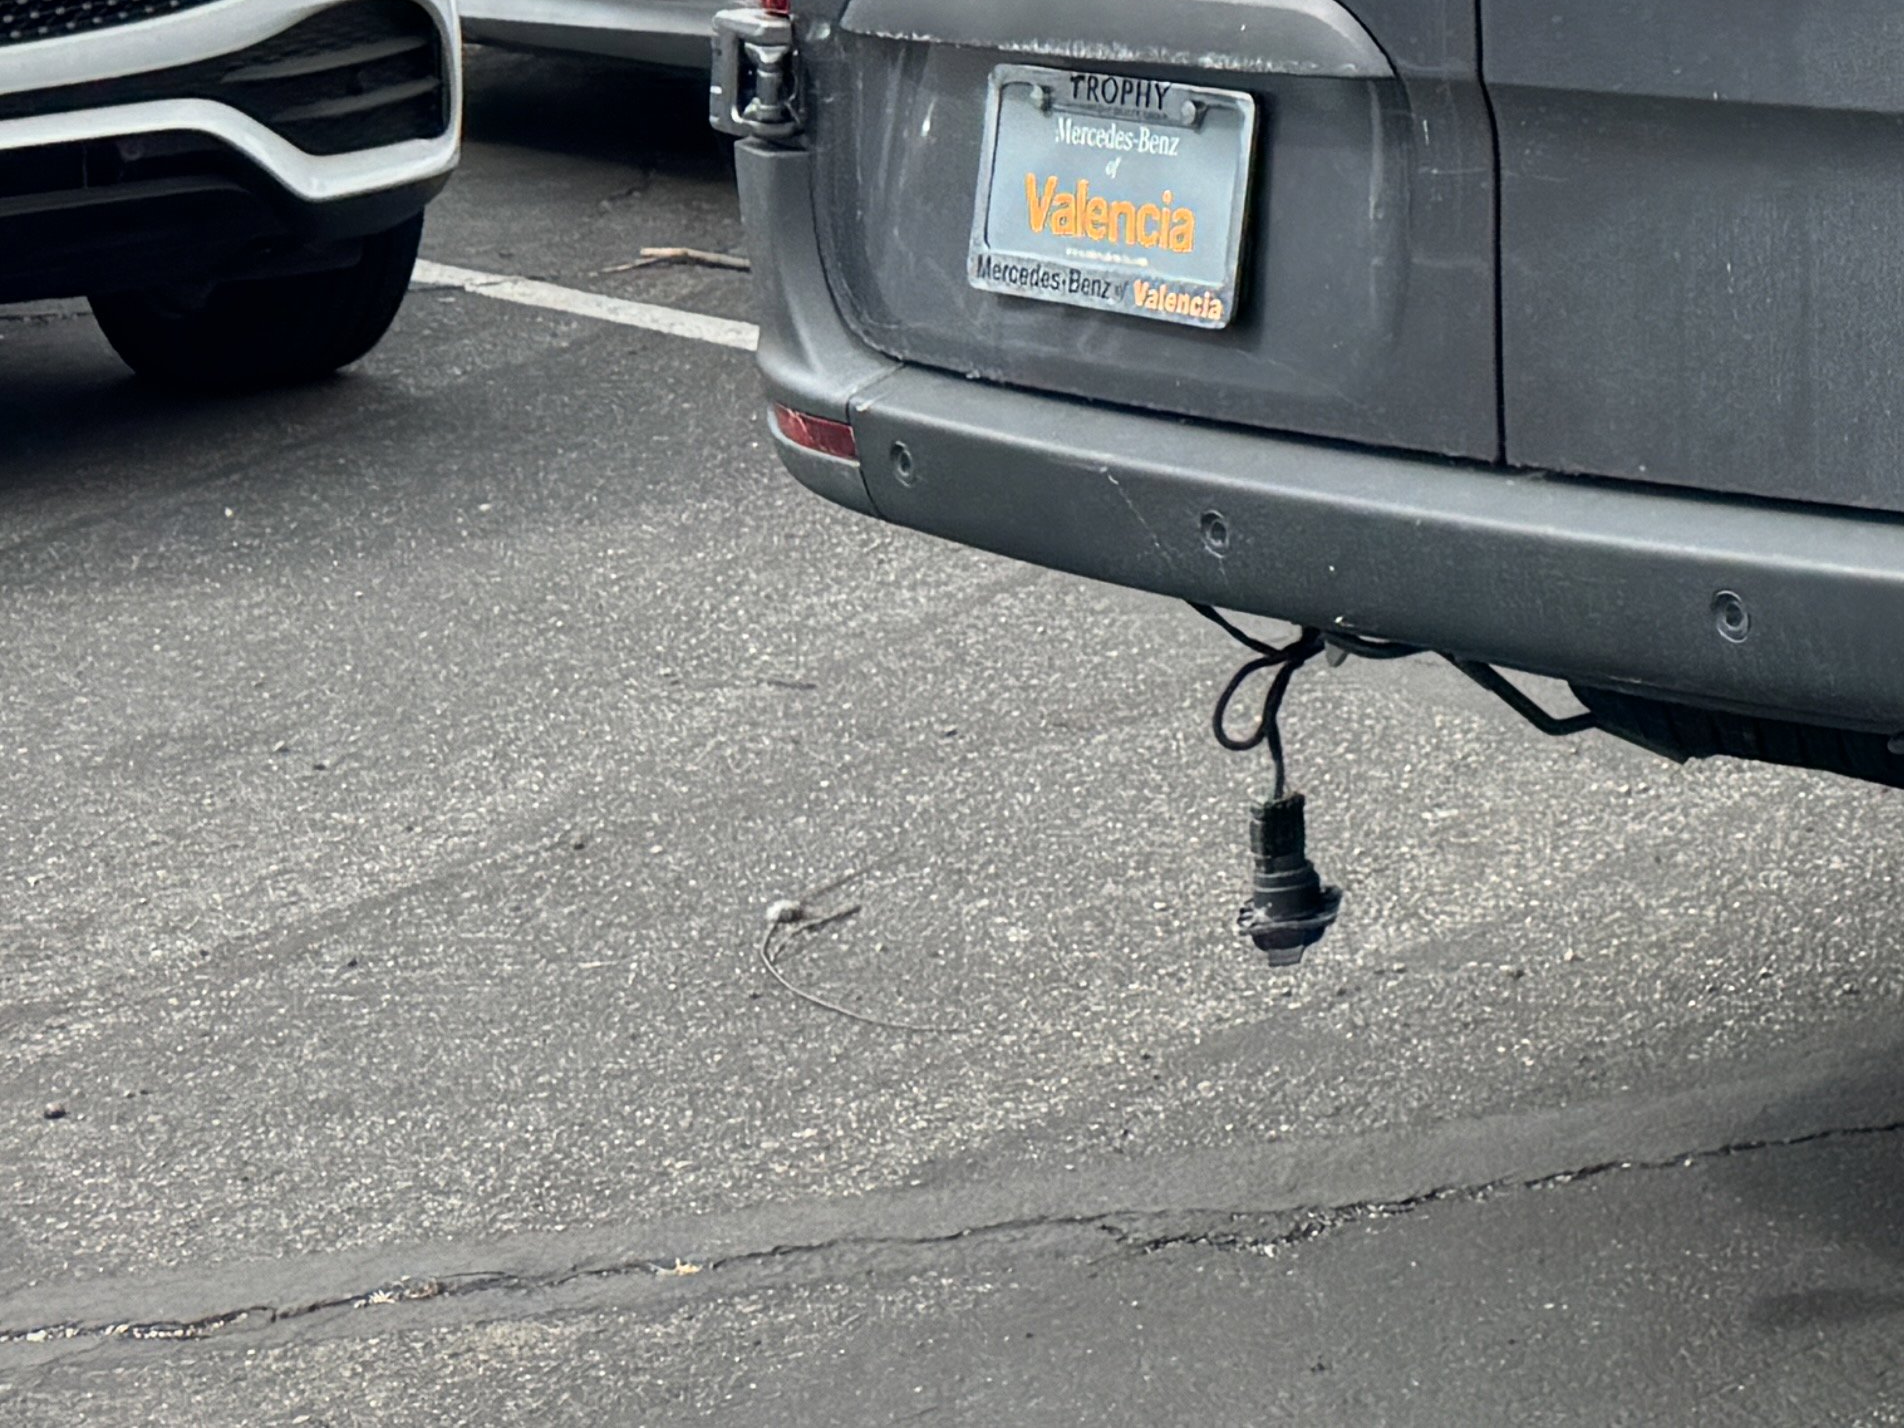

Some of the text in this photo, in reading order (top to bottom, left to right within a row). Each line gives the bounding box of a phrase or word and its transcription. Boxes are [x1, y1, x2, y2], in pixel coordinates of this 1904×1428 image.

[1070, 74, 1172, 110] TROPHY
[1055, 116, 1180, 156] Mercedes-Benz
[1025, 172, 1196, 253] Valencia
[1133, 278, 1224, 321] Valencia
